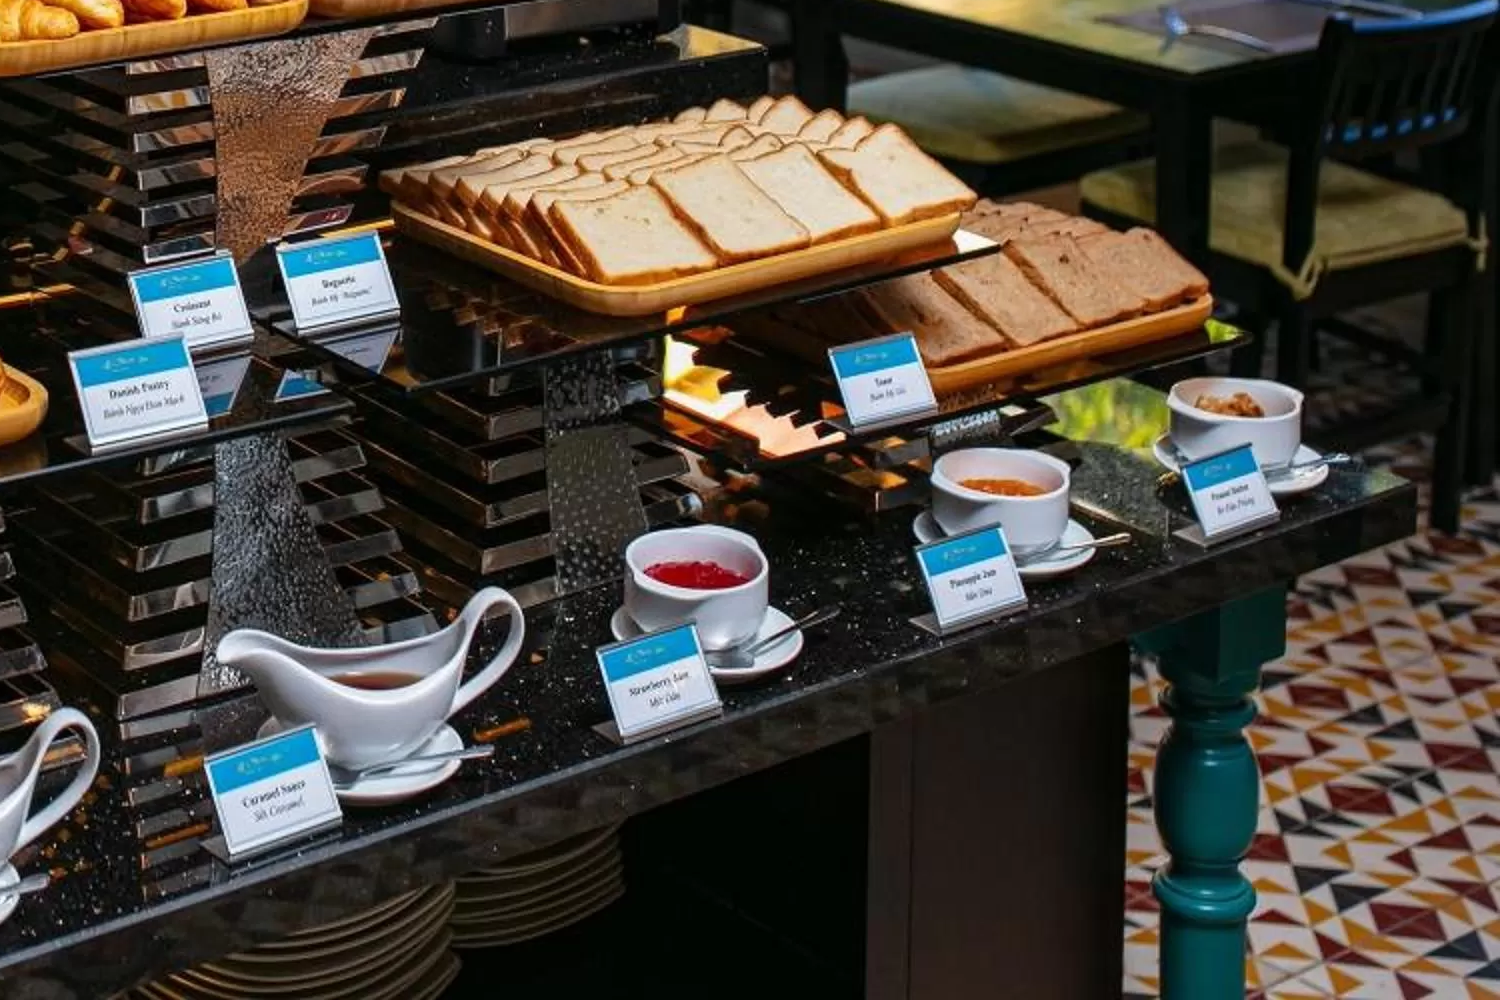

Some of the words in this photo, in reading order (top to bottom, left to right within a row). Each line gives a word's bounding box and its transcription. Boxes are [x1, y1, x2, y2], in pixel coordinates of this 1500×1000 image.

[108, 385, 140, 400] Danish
[141, 380, 169, 393] Pastry
[628, 676, 673, 697] Strawberry
[241, 787, 280, 809] Caramel
